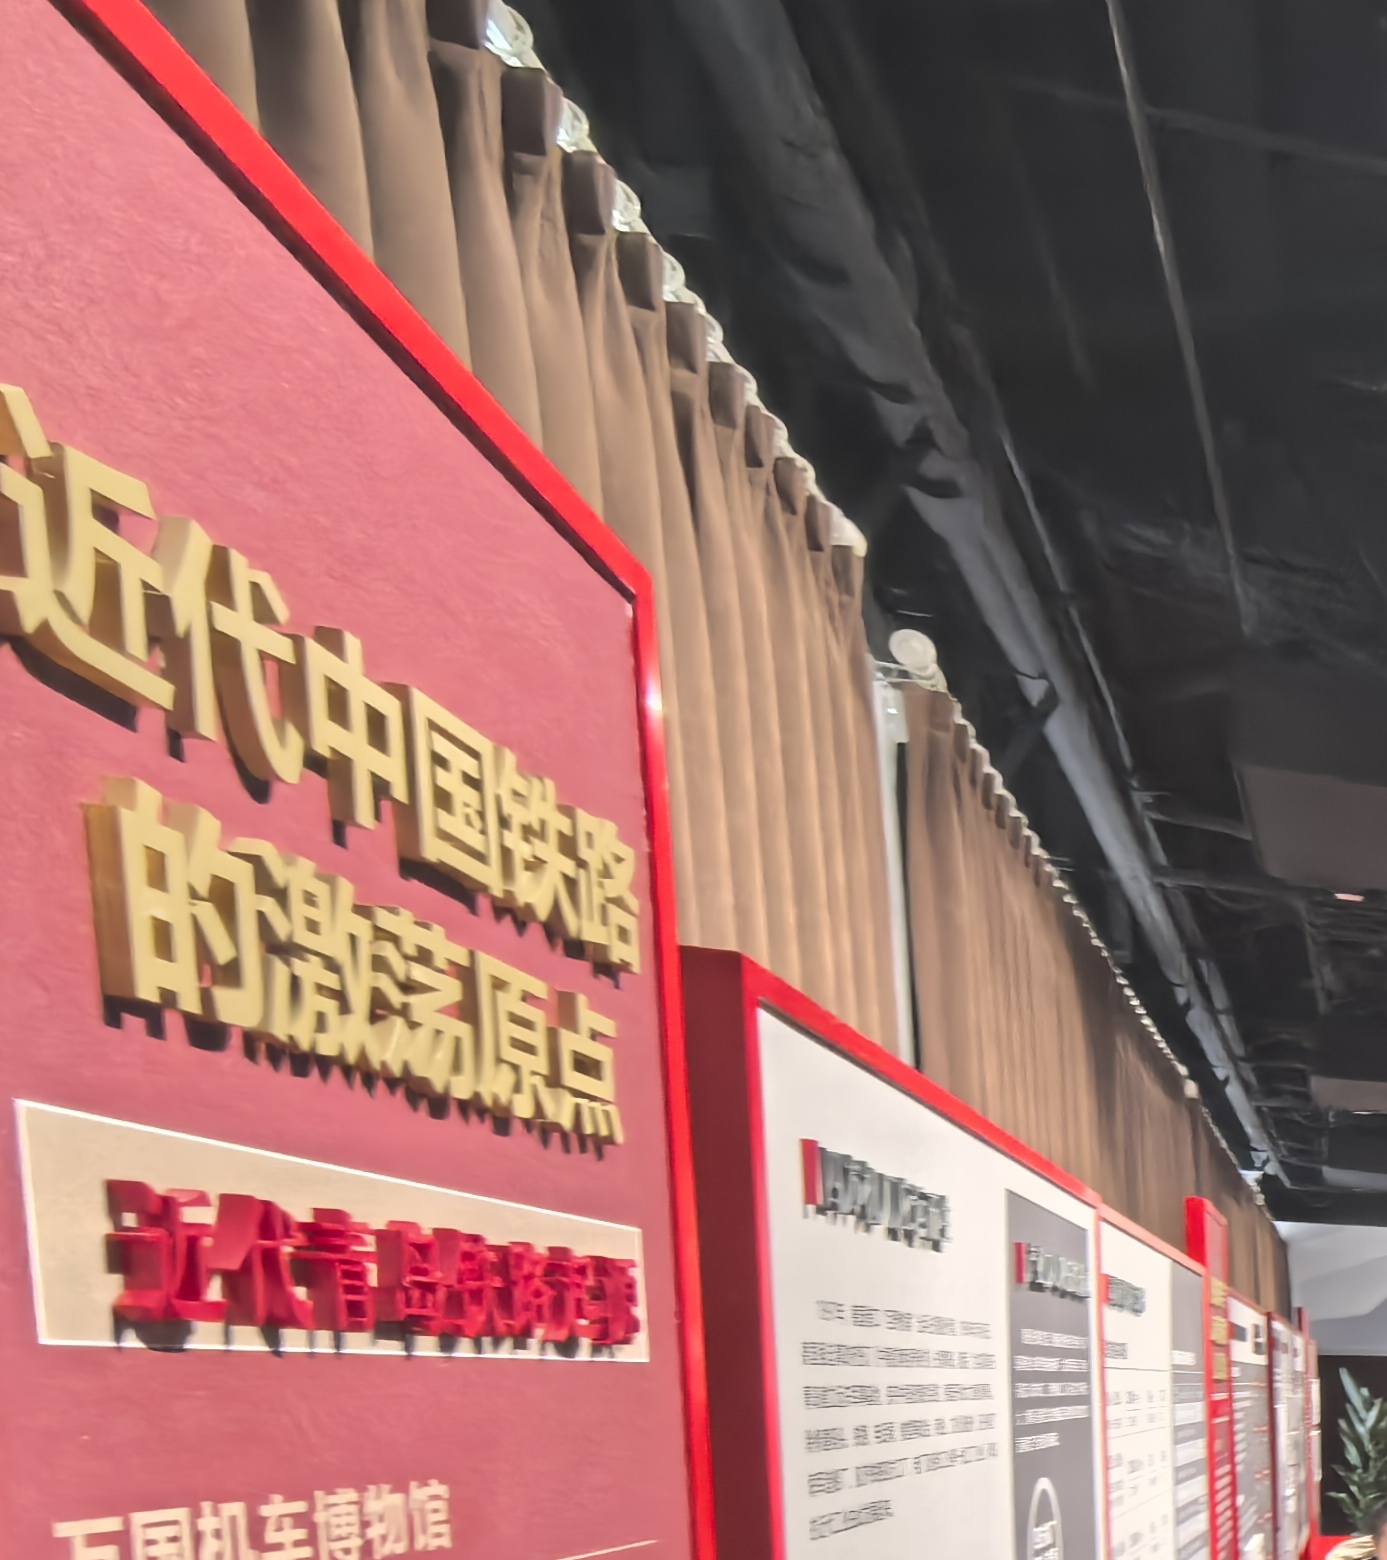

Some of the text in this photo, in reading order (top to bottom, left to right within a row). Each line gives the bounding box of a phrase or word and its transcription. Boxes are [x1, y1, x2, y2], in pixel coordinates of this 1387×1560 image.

[0, 382, 640, 974] 近代中国铁路
[85, 777, 625, 1146] 的激荡原点
